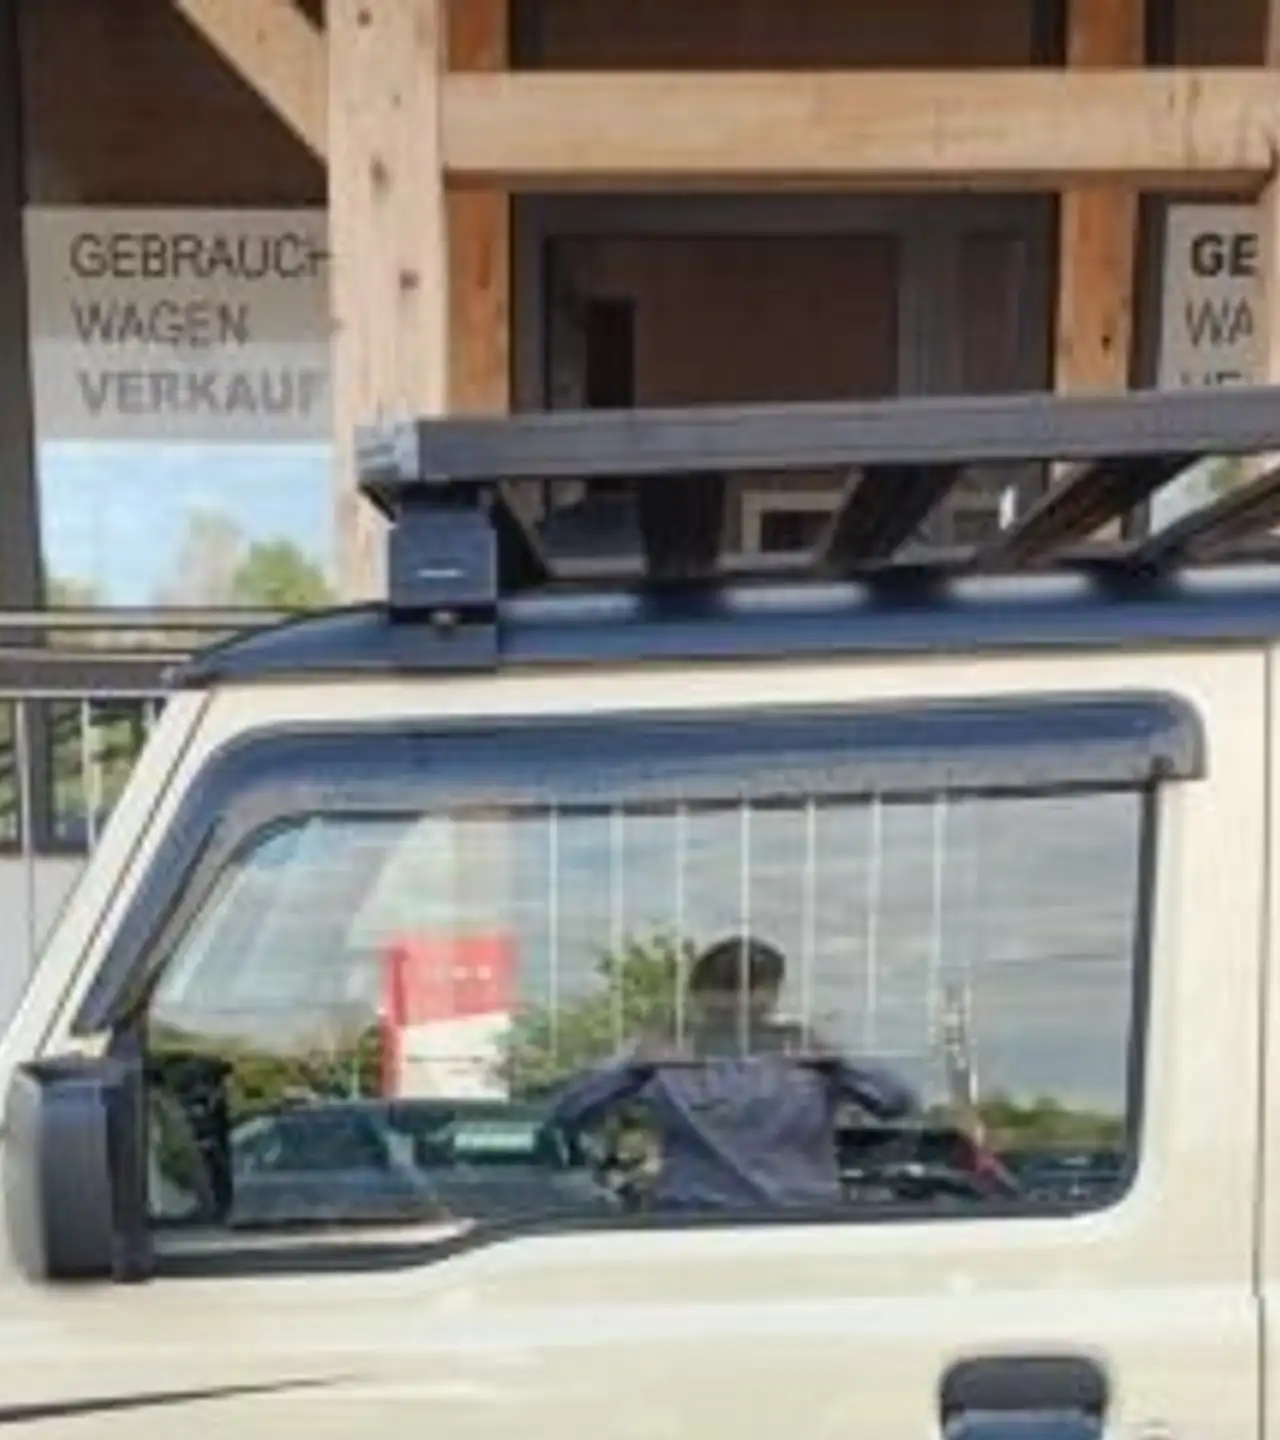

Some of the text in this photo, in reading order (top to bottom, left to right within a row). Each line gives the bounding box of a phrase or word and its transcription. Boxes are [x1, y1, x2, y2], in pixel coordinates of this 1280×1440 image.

[70, 231, 330, 280] GEBRAUCH
[72, 300, 250, 347] WAGEN
[77, 367, 328, 416] VERKAUF
